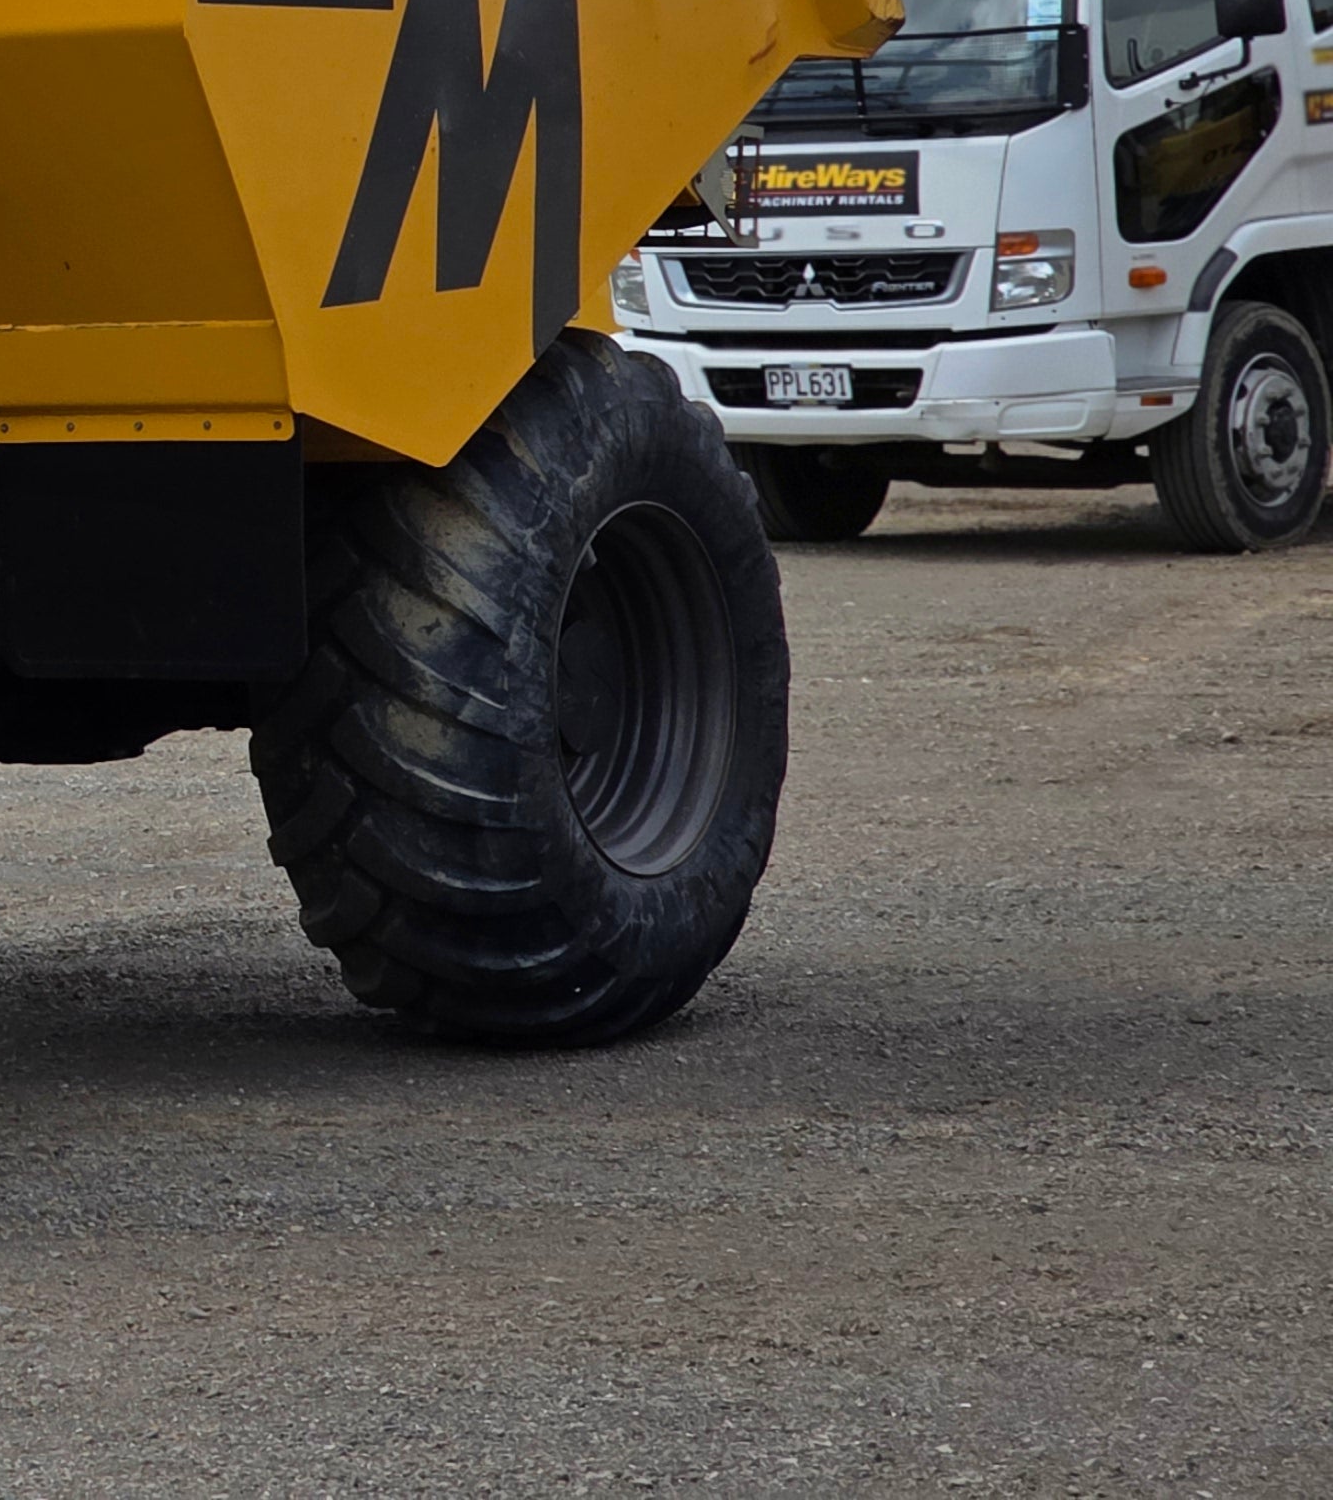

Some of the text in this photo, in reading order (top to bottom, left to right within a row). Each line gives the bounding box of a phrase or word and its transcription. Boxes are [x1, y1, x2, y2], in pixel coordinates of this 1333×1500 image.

[751, 163, 906, 192] HireWays
[838, 194, 904, 206] RENTALS
[768, 371, 847, 396] PPL631
